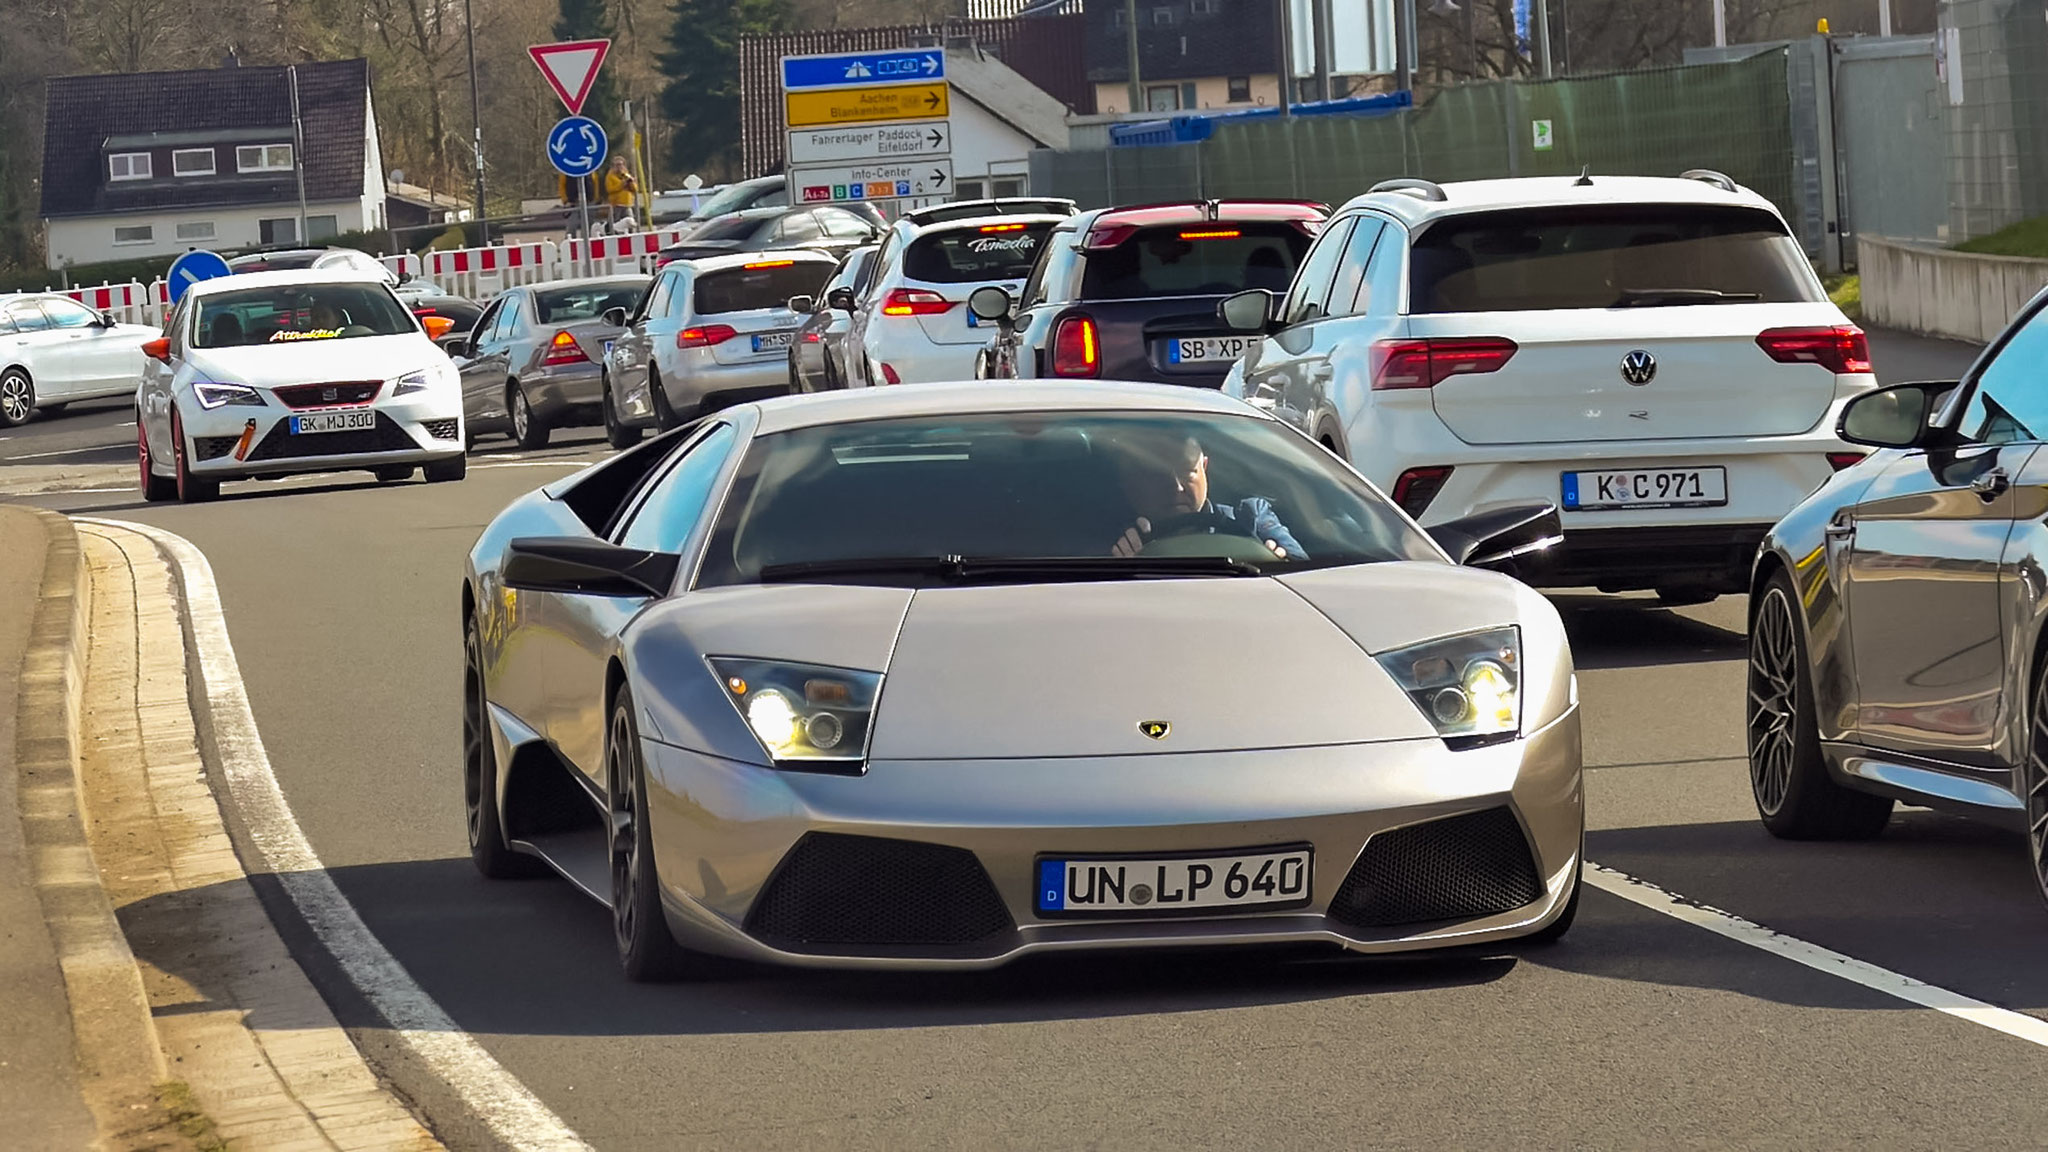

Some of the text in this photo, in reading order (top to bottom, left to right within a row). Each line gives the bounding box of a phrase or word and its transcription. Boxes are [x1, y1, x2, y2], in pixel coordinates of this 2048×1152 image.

[860, 93, 898, 104] Aachen
[830, 104, 899, 118] Blankenheim
[812, 129, 922, 145] Fahrerlager Paddock
[878, 141, 922, 153] Eifeldorf
[852, 168, 912, 180] Info-Center
[836, 187, 844, 198] B
[852, 185, 861, 196] C
[1181, 341, 1206, 359] SB
[1219, 339, 1243, 357] XP
[300, 413, 374, 431] GK MJ 300
[1597, 475, 1615, 500] K
[1633, 474, 1650, 498] C
[1656, 473, 1704, 498] 971
[1047, 857, 1303, 904] D UN LP 640
